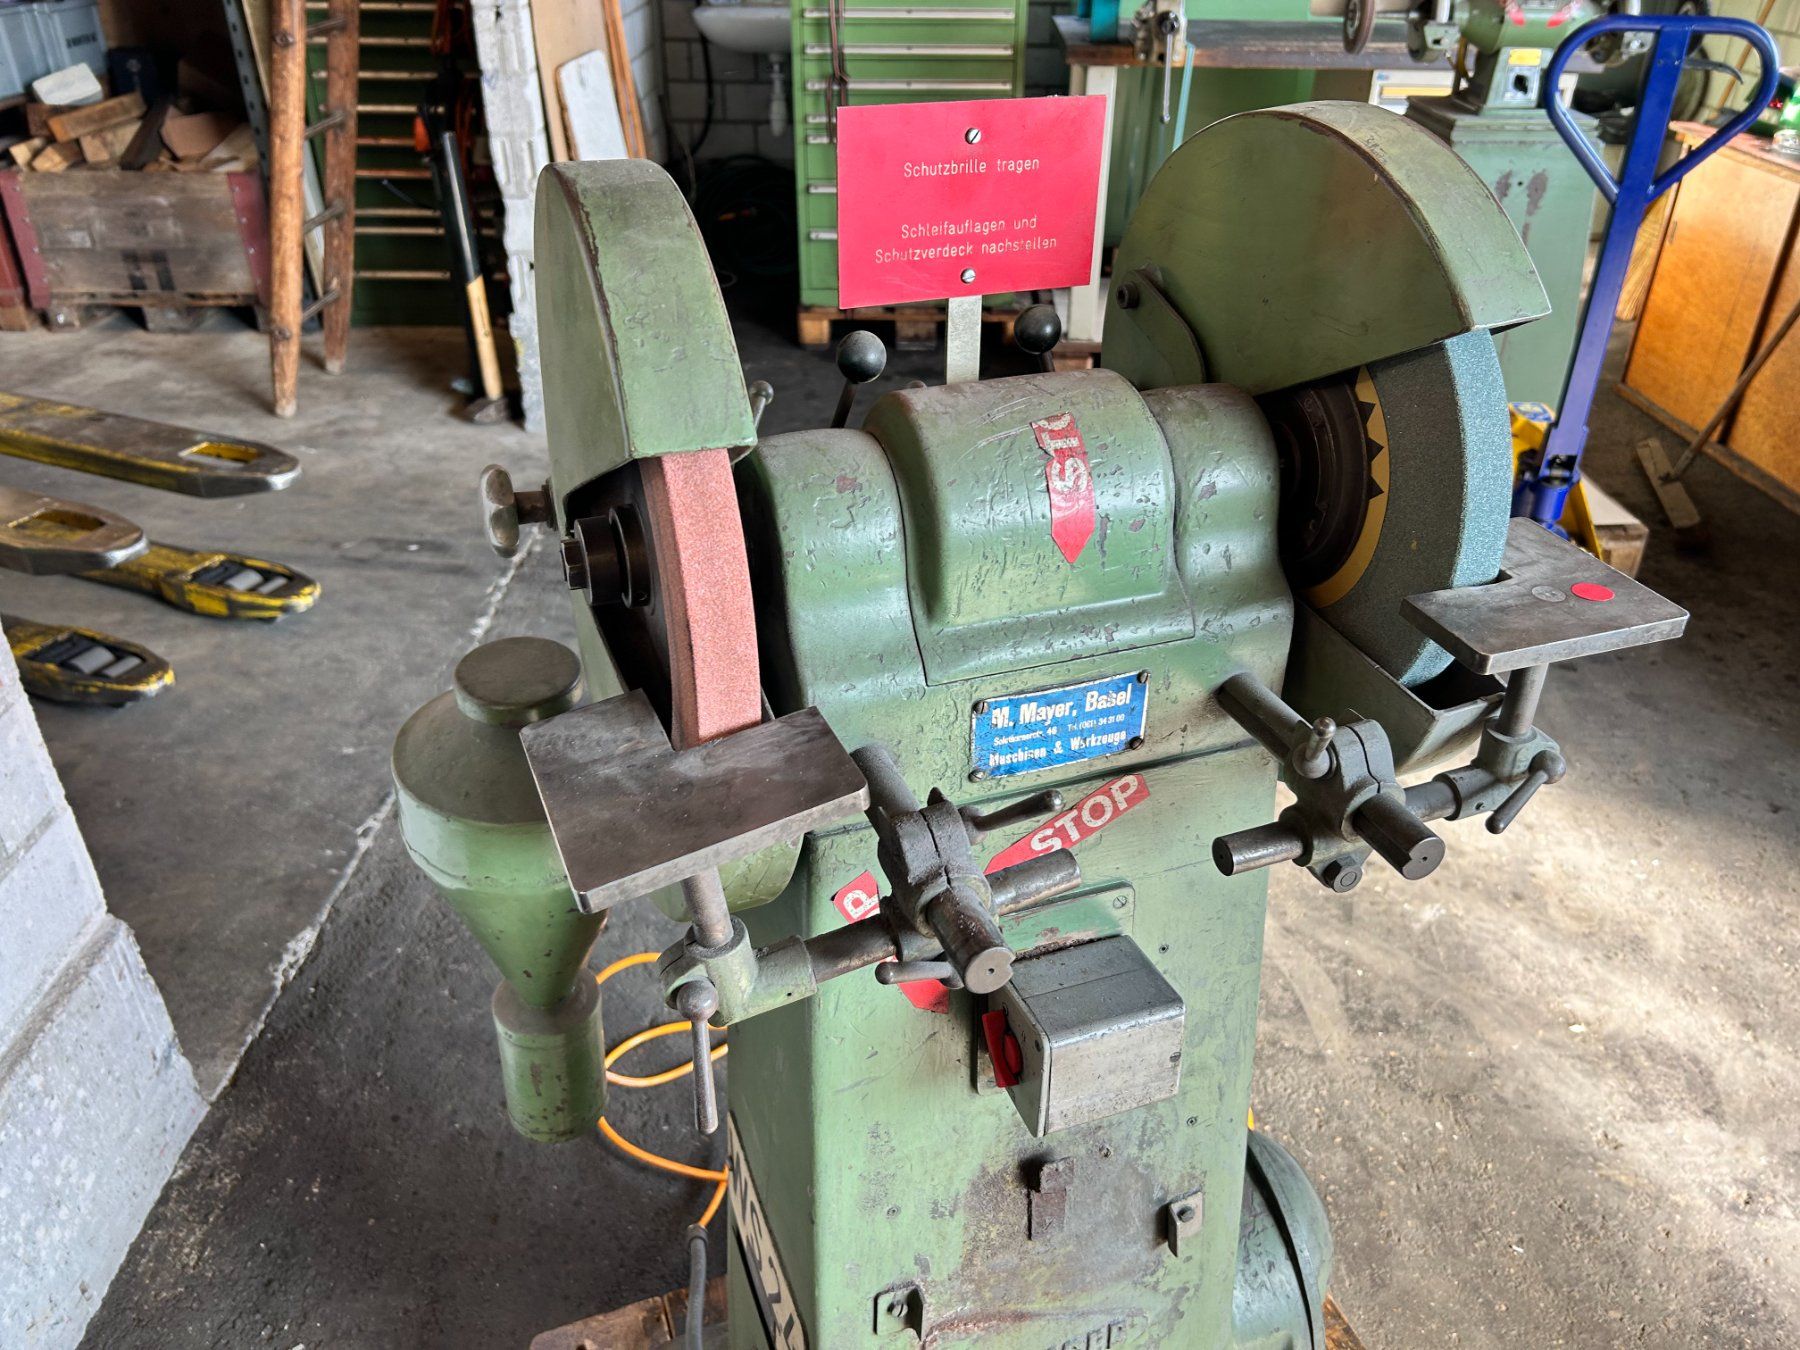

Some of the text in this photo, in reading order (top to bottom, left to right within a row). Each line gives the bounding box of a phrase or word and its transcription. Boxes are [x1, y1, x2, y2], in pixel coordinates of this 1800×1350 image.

[904, 158, 1040, 178] Schutzbrille tragen
[901, 215, 1037, 239] Schleifauflagen und
[875, 242, 973, 264] Schutzverdeck
[991, 683, 1132, 730] M. Mayer, Basel
[1053, 740, 1064, 754] &
[1030, 774, 1139, 857] STOP
